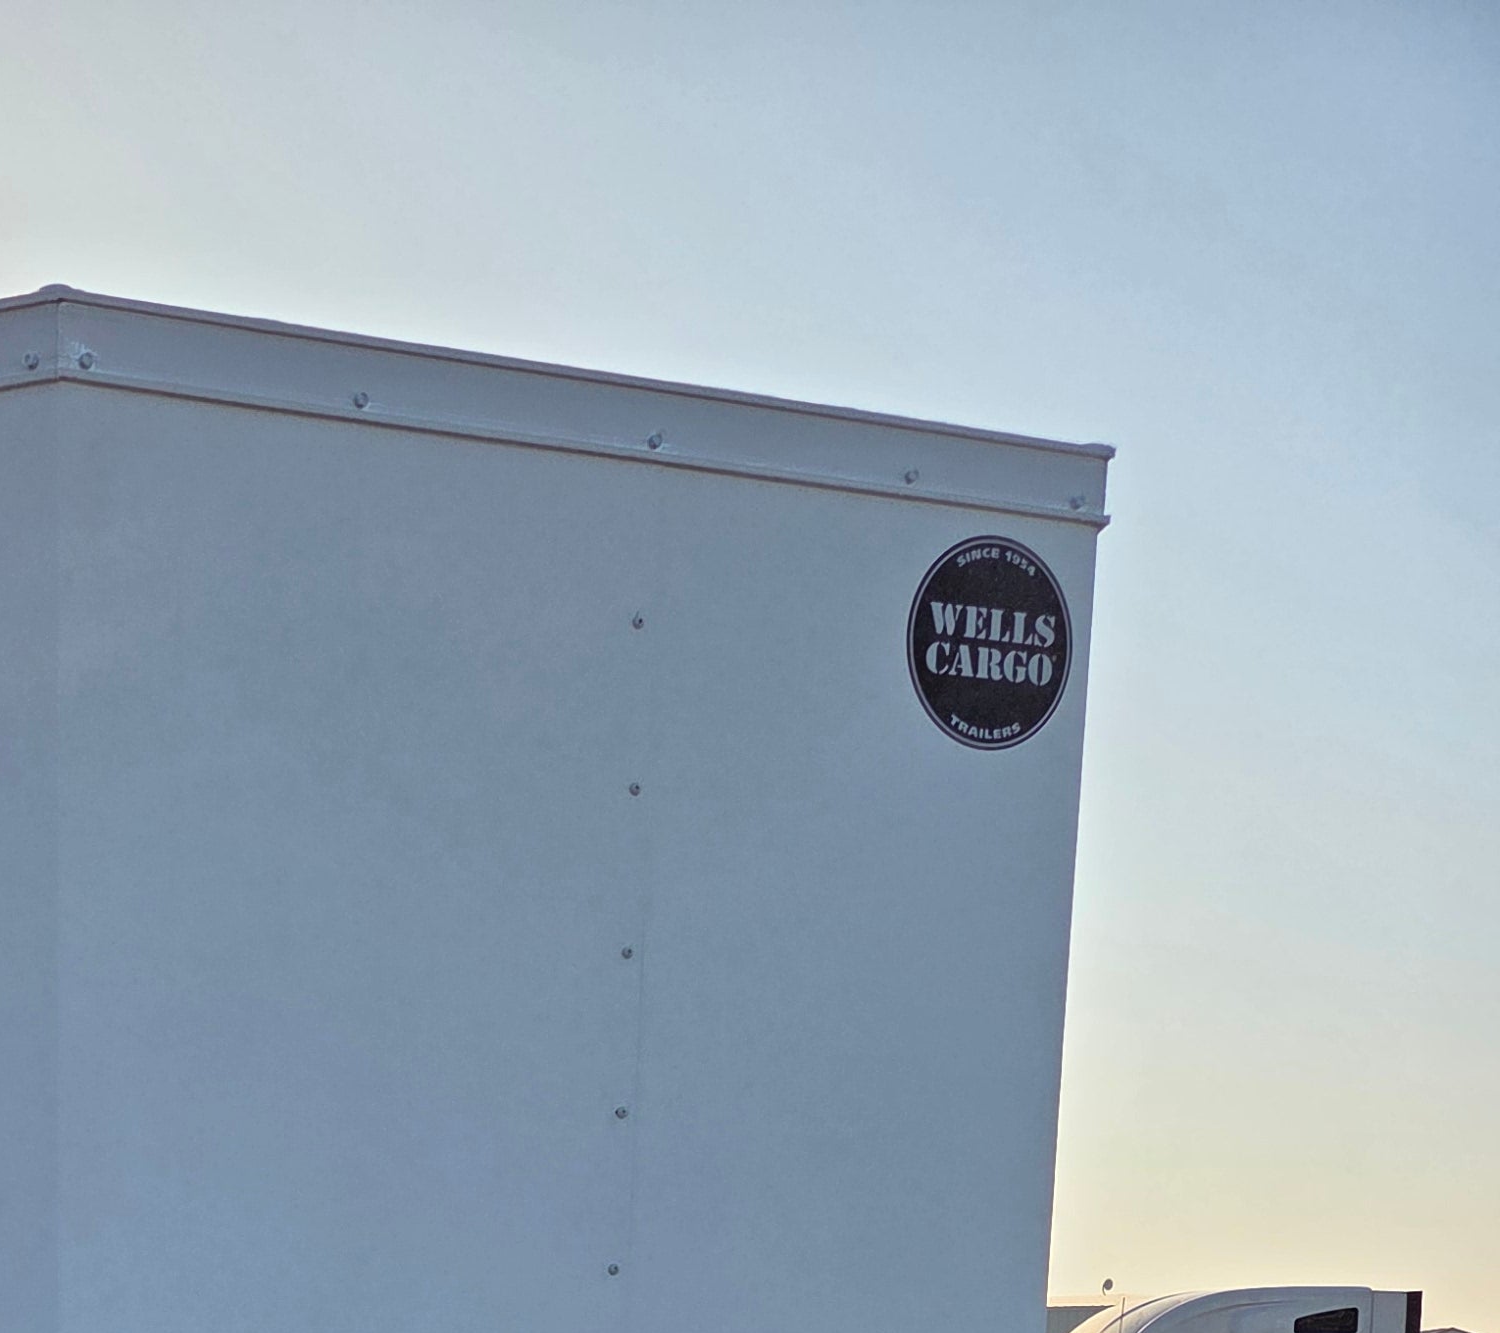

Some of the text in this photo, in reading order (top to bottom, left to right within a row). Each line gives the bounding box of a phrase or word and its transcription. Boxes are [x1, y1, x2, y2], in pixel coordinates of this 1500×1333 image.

[955, 547, 1037, 577] SINCE 1954
[929, 600, 1057, 649] WELLS
[925, 640, 1054, 687] CARGO
[949, 713, 1022, 740] TRAILERS
